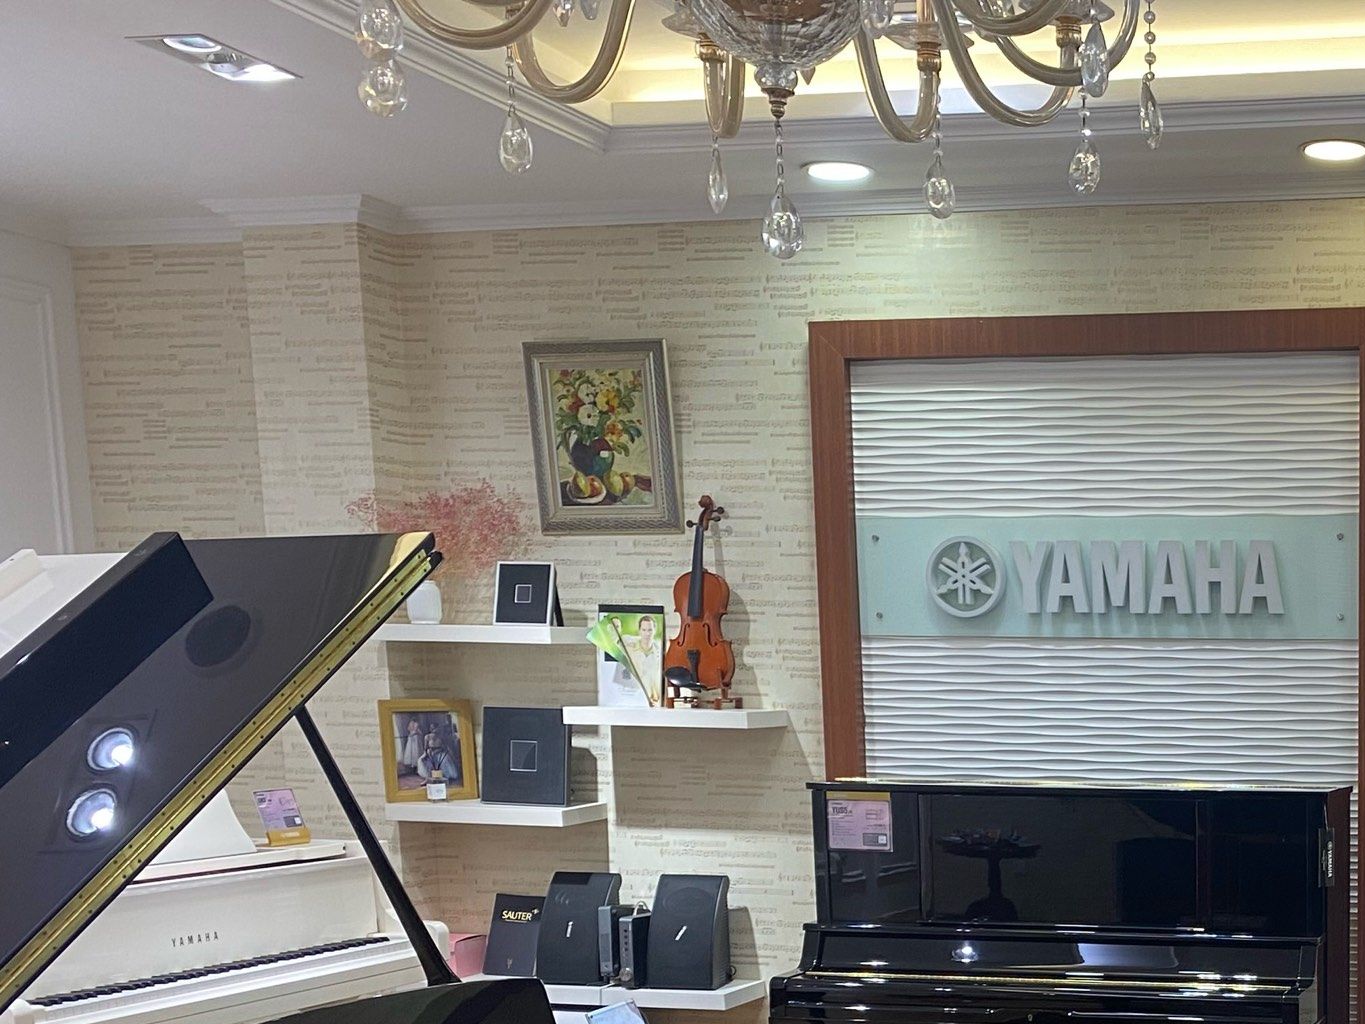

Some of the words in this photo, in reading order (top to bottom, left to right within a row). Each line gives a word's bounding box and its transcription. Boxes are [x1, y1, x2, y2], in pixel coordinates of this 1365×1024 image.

[1008, 540, 1285, 614] YAMAHA
[501, 910, 532, 921] SAUTER
[171, 931, 218, 947] YAMAHA
